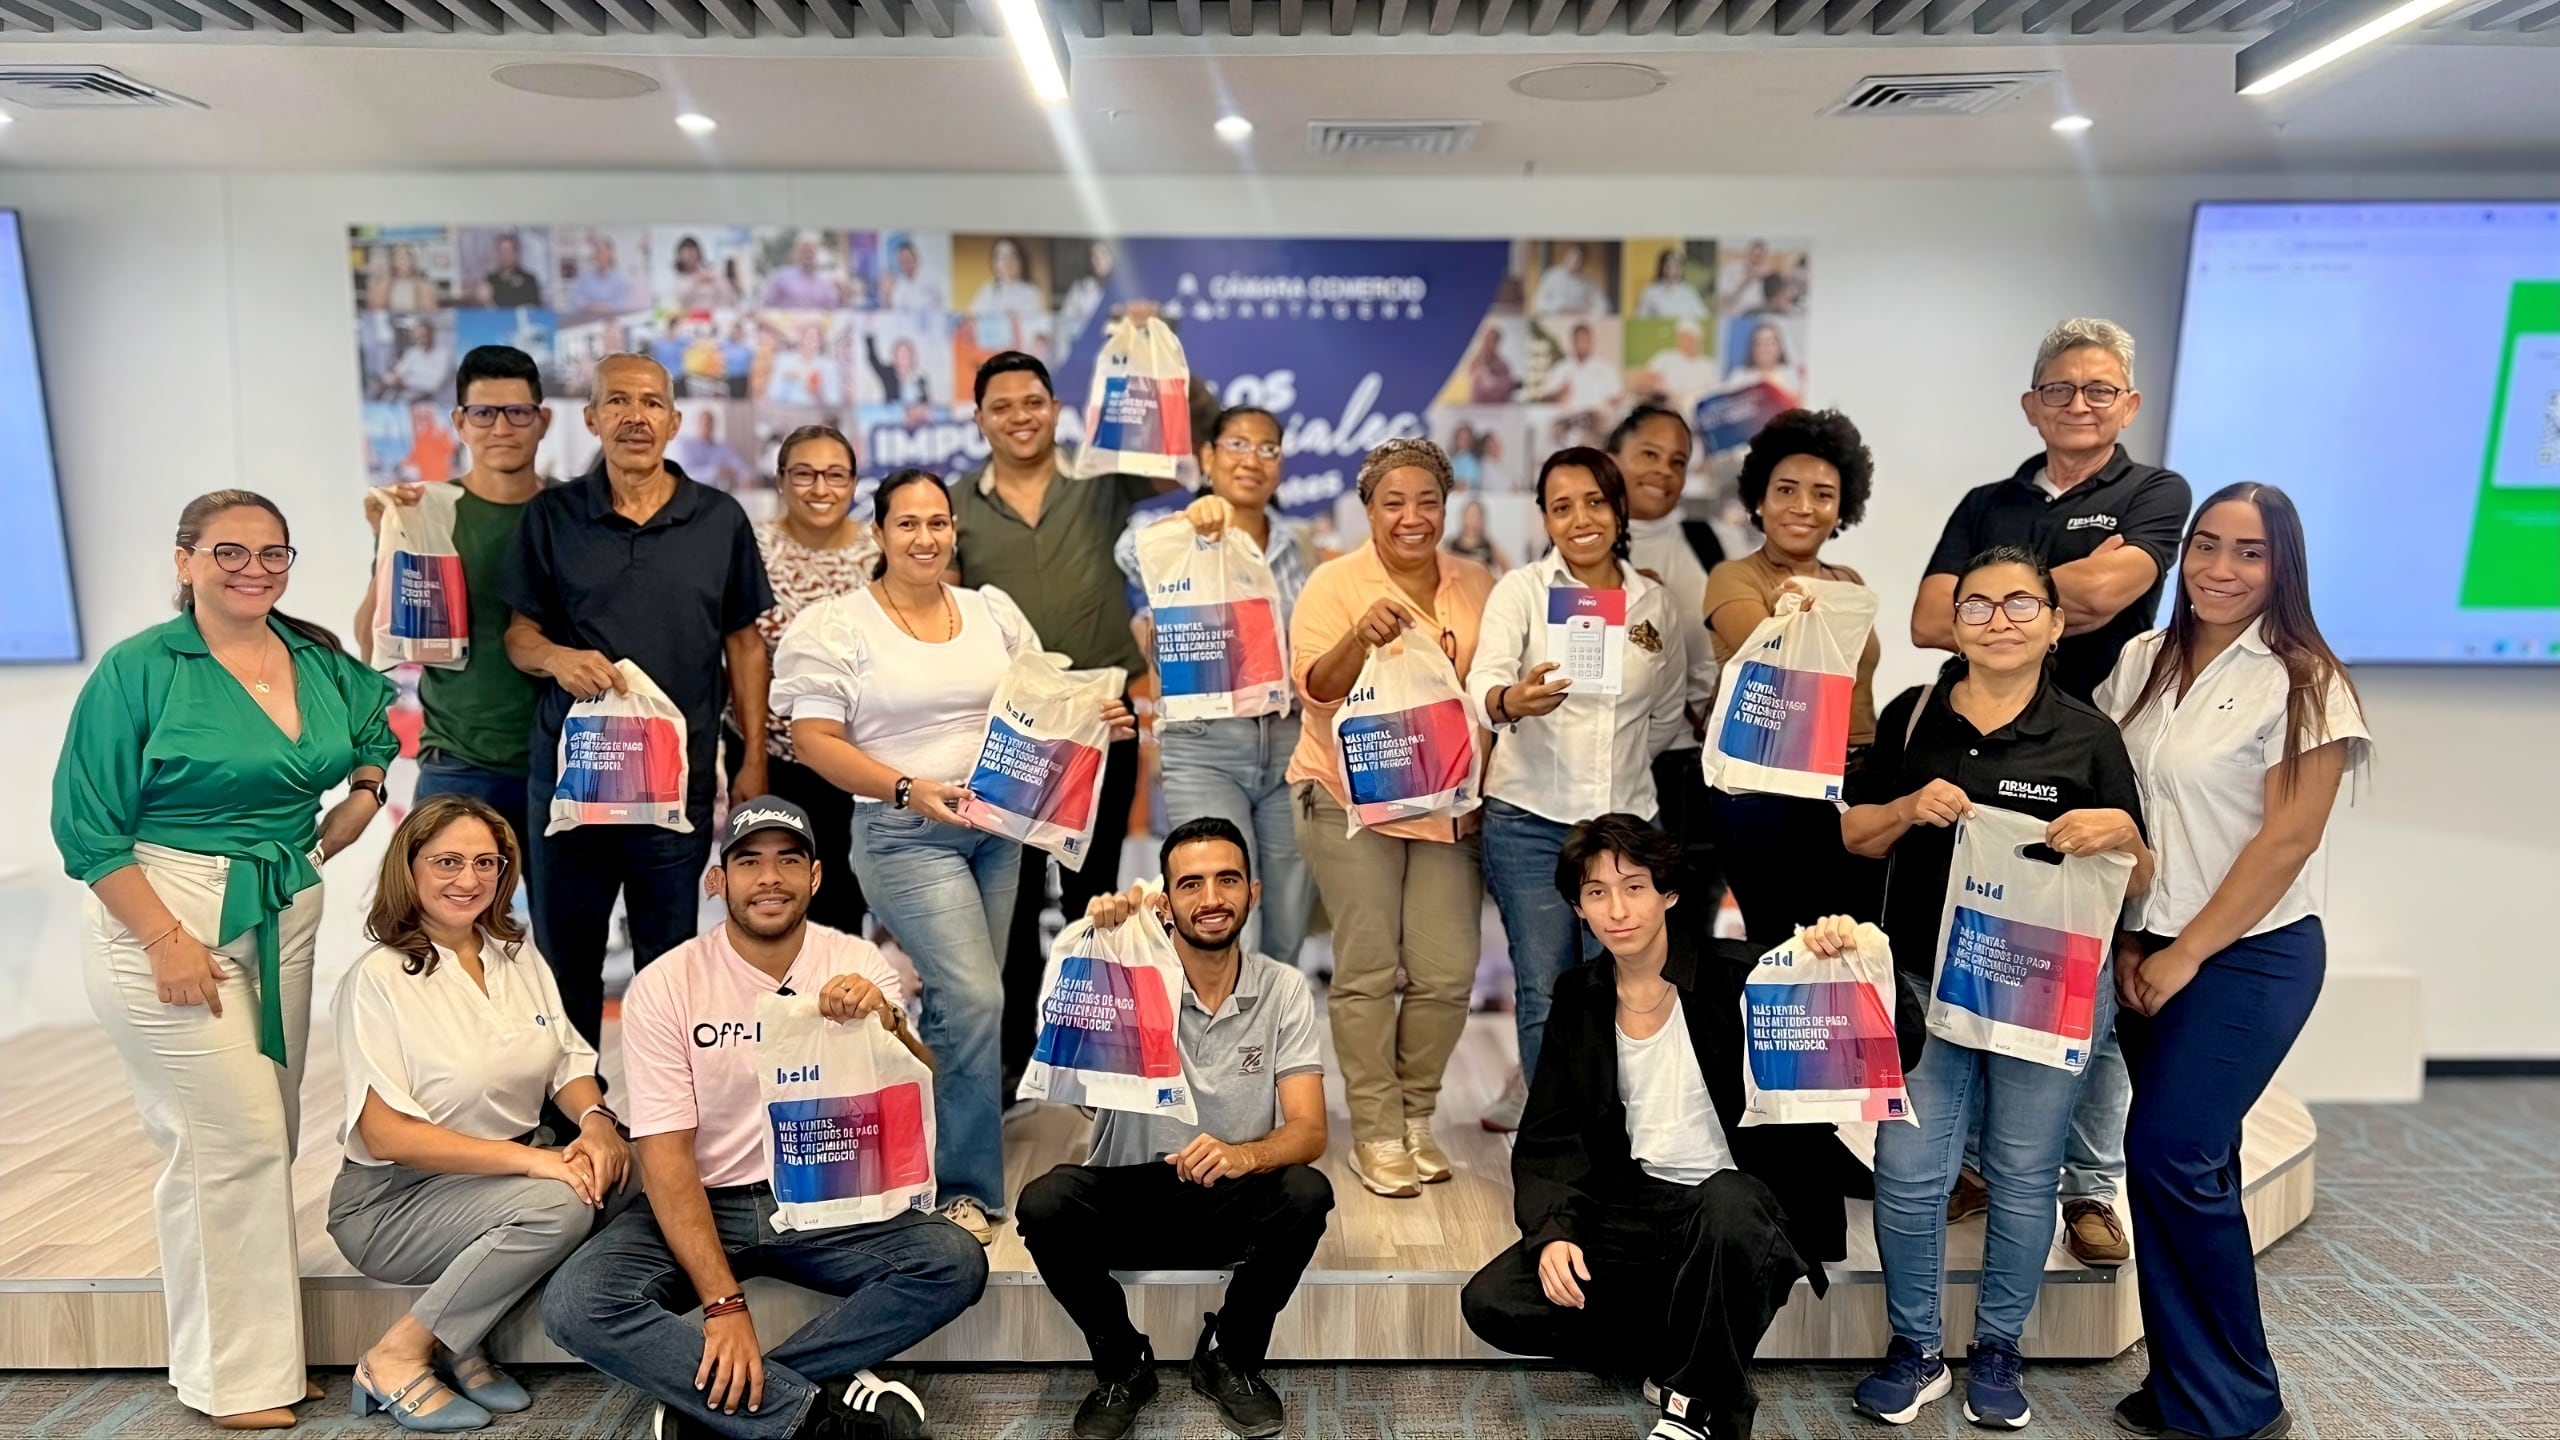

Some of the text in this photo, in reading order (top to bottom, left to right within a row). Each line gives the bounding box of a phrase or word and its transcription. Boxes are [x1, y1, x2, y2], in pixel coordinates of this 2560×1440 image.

[1158, 577, 1191, 594] bold
[1005, 700, 1034, 728] bold
[1965, 875, 2004, 900] bold
[1761, 950, 1793, 967] old
[2013, 953, 2024, 966] DE
[1812, 1016, 1825, 1027] DE
[1774, 1040, 1787, 1051] TU
[777, 1064, 820, 1085] bold
[843, 1127, 854, 1138] DE
[856, 1124, 879, 1137] PAGO
[804, 1152, 815, 1165] TU
